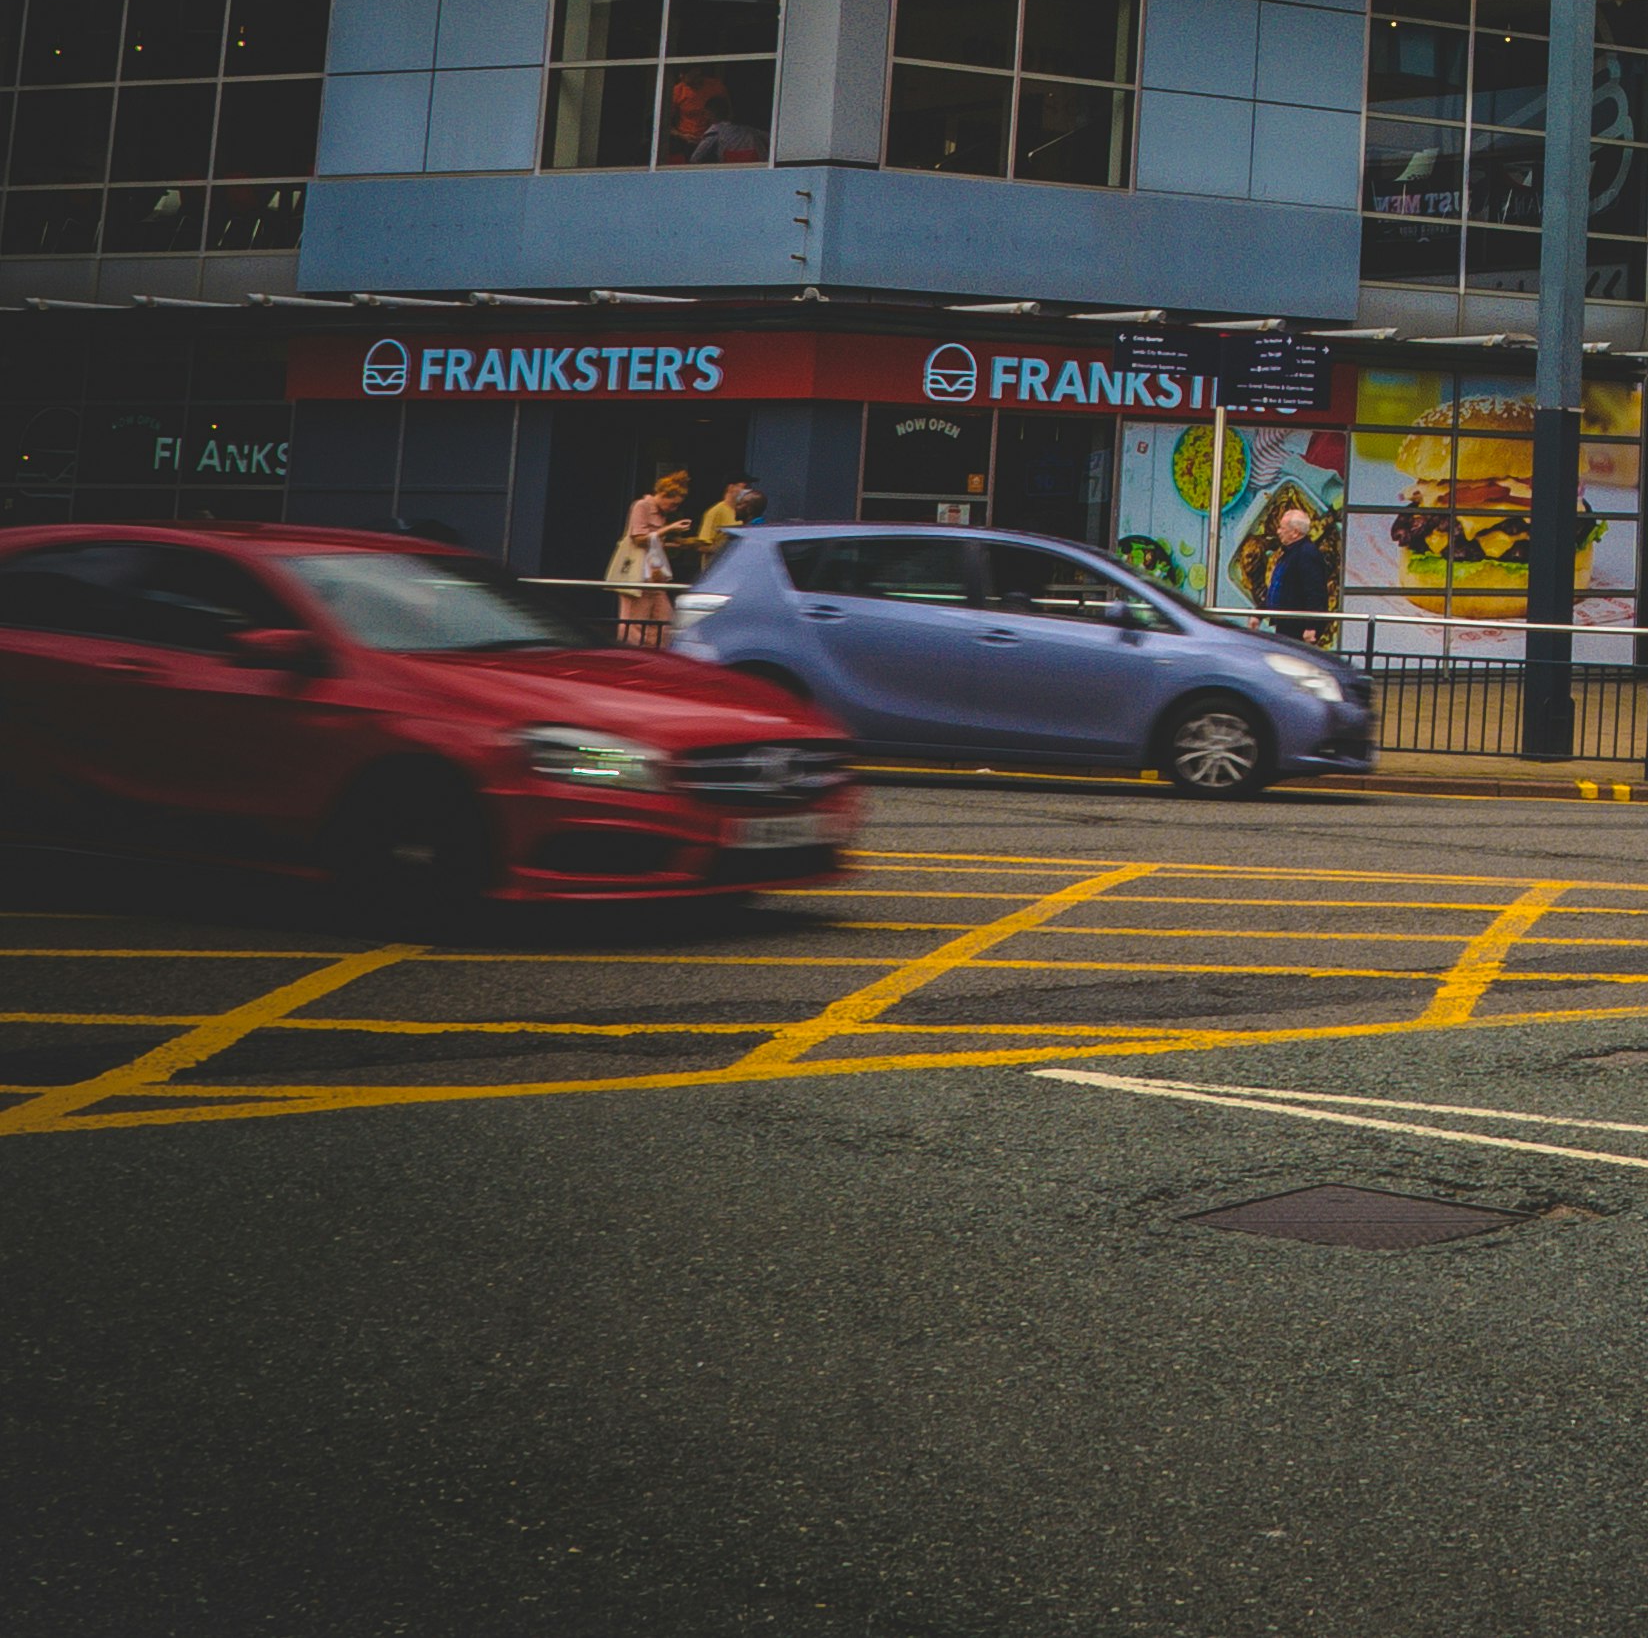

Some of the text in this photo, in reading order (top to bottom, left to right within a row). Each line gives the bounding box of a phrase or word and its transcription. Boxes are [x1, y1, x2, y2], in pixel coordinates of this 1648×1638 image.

[419, 346, 725, 392] FRANKSTER'S
[896, 418, 961, 439] NOW OPEN
